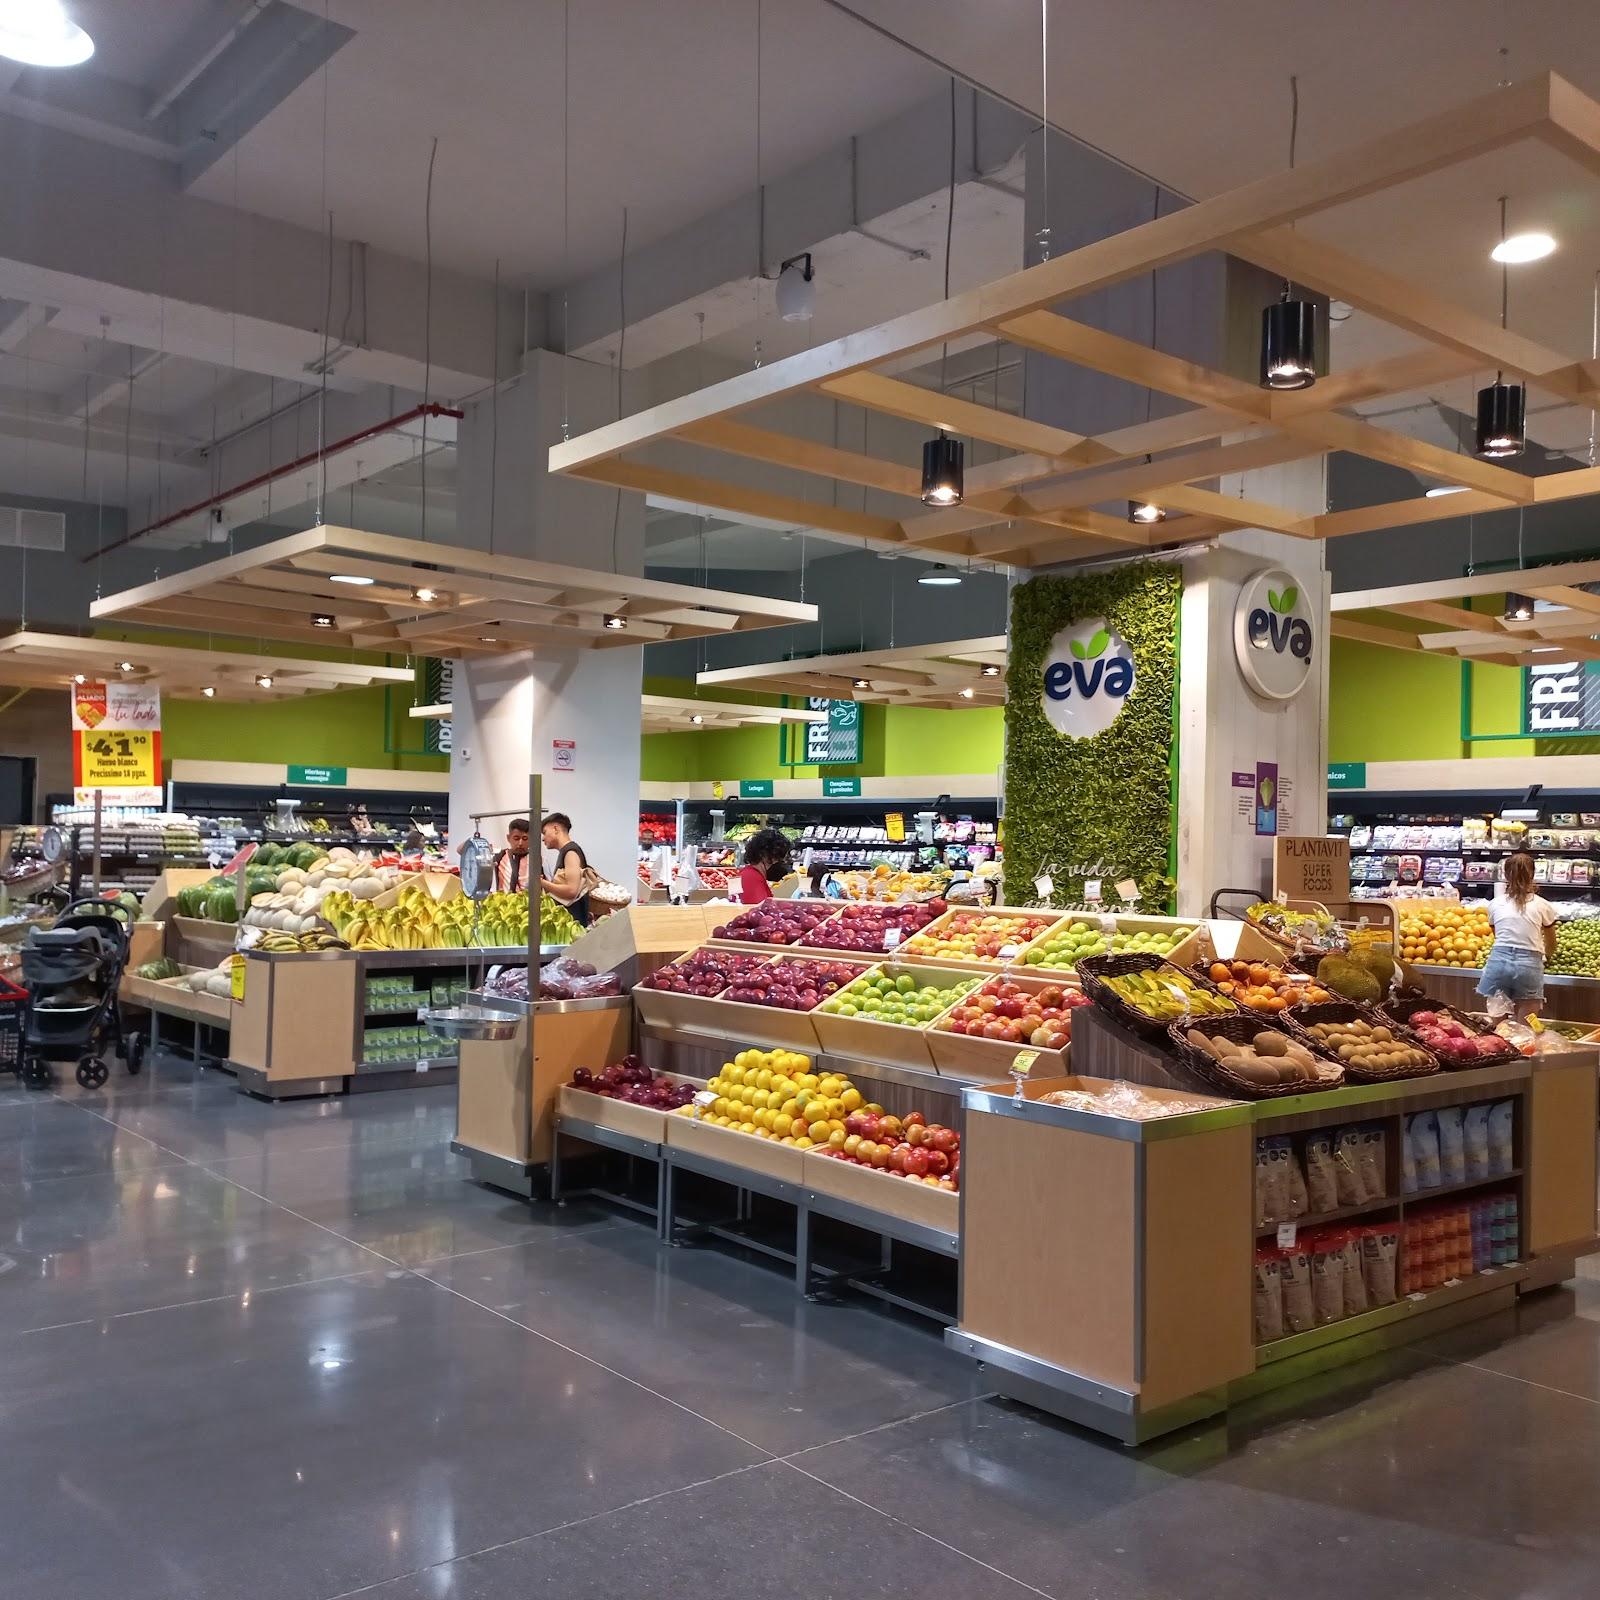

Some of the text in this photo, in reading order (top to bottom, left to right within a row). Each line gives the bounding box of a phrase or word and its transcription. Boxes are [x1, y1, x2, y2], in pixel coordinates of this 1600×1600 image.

[1249, 608, 1312, 659] eva
[1044, 656, 1134, 701] eva
[133, 736, 146, 744] 90
[1285, 839, 1345, 858] PLANTAVIT
[1303, 863, 1332, 878] SUPER
[1303, 878, 1333, 892] FOODS
